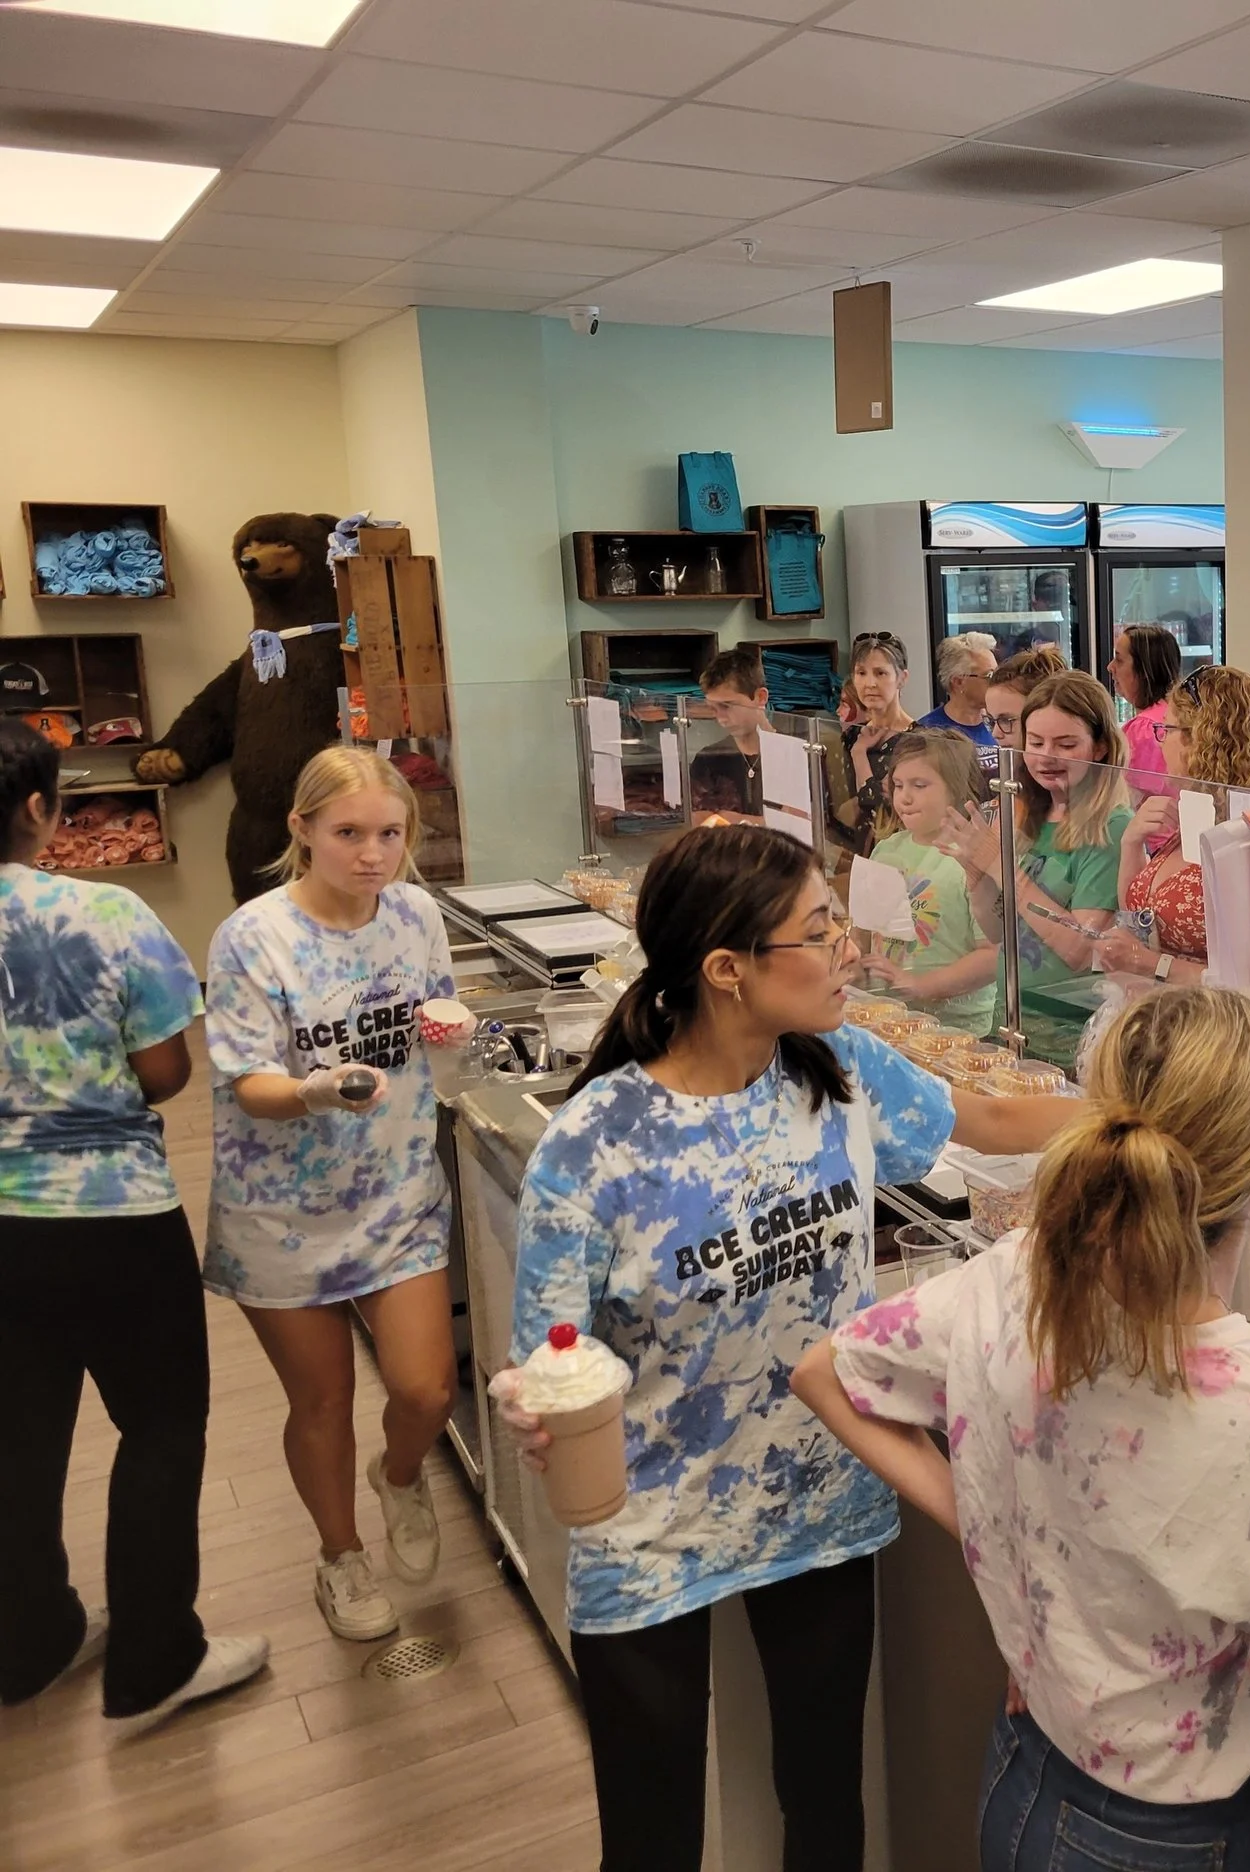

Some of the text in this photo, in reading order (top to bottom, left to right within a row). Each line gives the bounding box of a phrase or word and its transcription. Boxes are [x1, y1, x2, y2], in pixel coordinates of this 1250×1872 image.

[348, 983, 401, 1009] National
[338, 1025, 416, 1065] SUNDAY
[737, 1175, 797, 1214] National
[750, 1179, 860, 1246] CREAM
[732, 1226, 825, 1285] SUNDAY
[734, 1249, 827, 1307] FUNDAY
